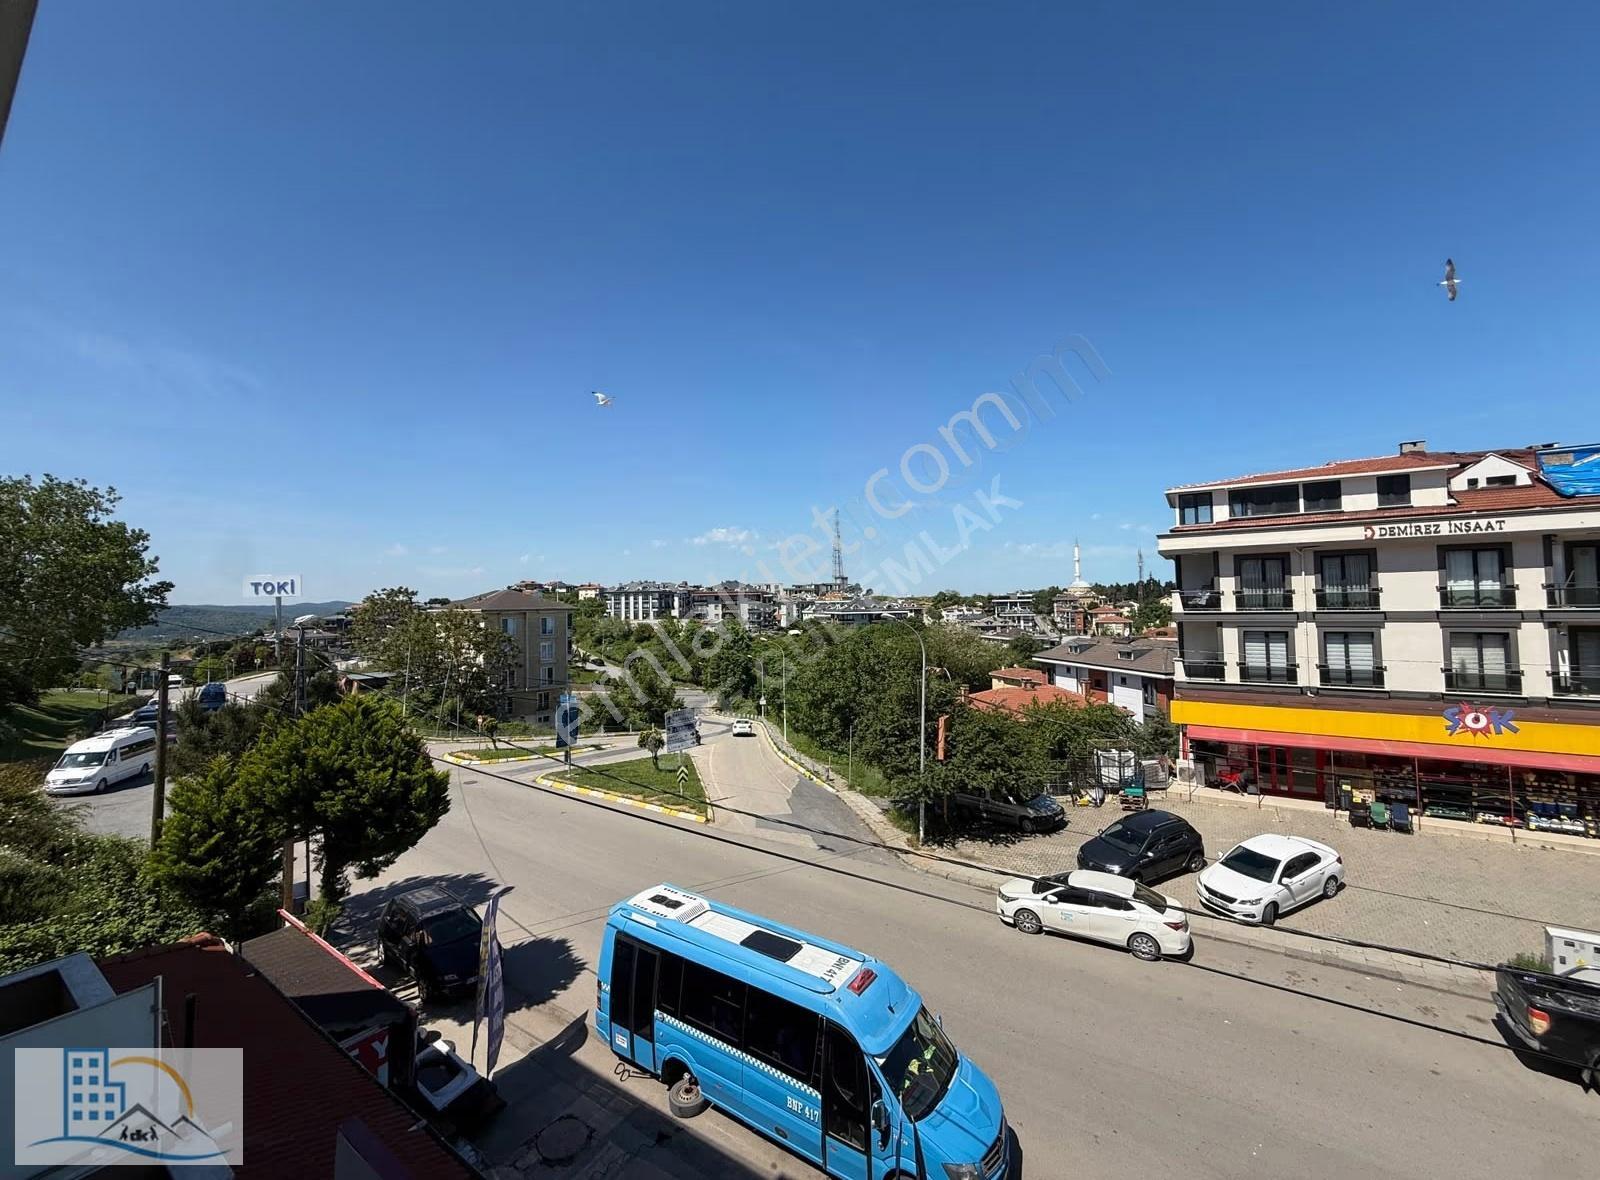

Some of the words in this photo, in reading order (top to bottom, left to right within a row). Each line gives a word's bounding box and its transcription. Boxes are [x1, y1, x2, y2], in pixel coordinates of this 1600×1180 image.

[1378, 523, 1441, 537] DEMİREZ
[1448, 520, 1506, 534] İNŞAAT
[250, 579, 296, 595] TOKİ
[804, 1105, 819, 1123] 417
